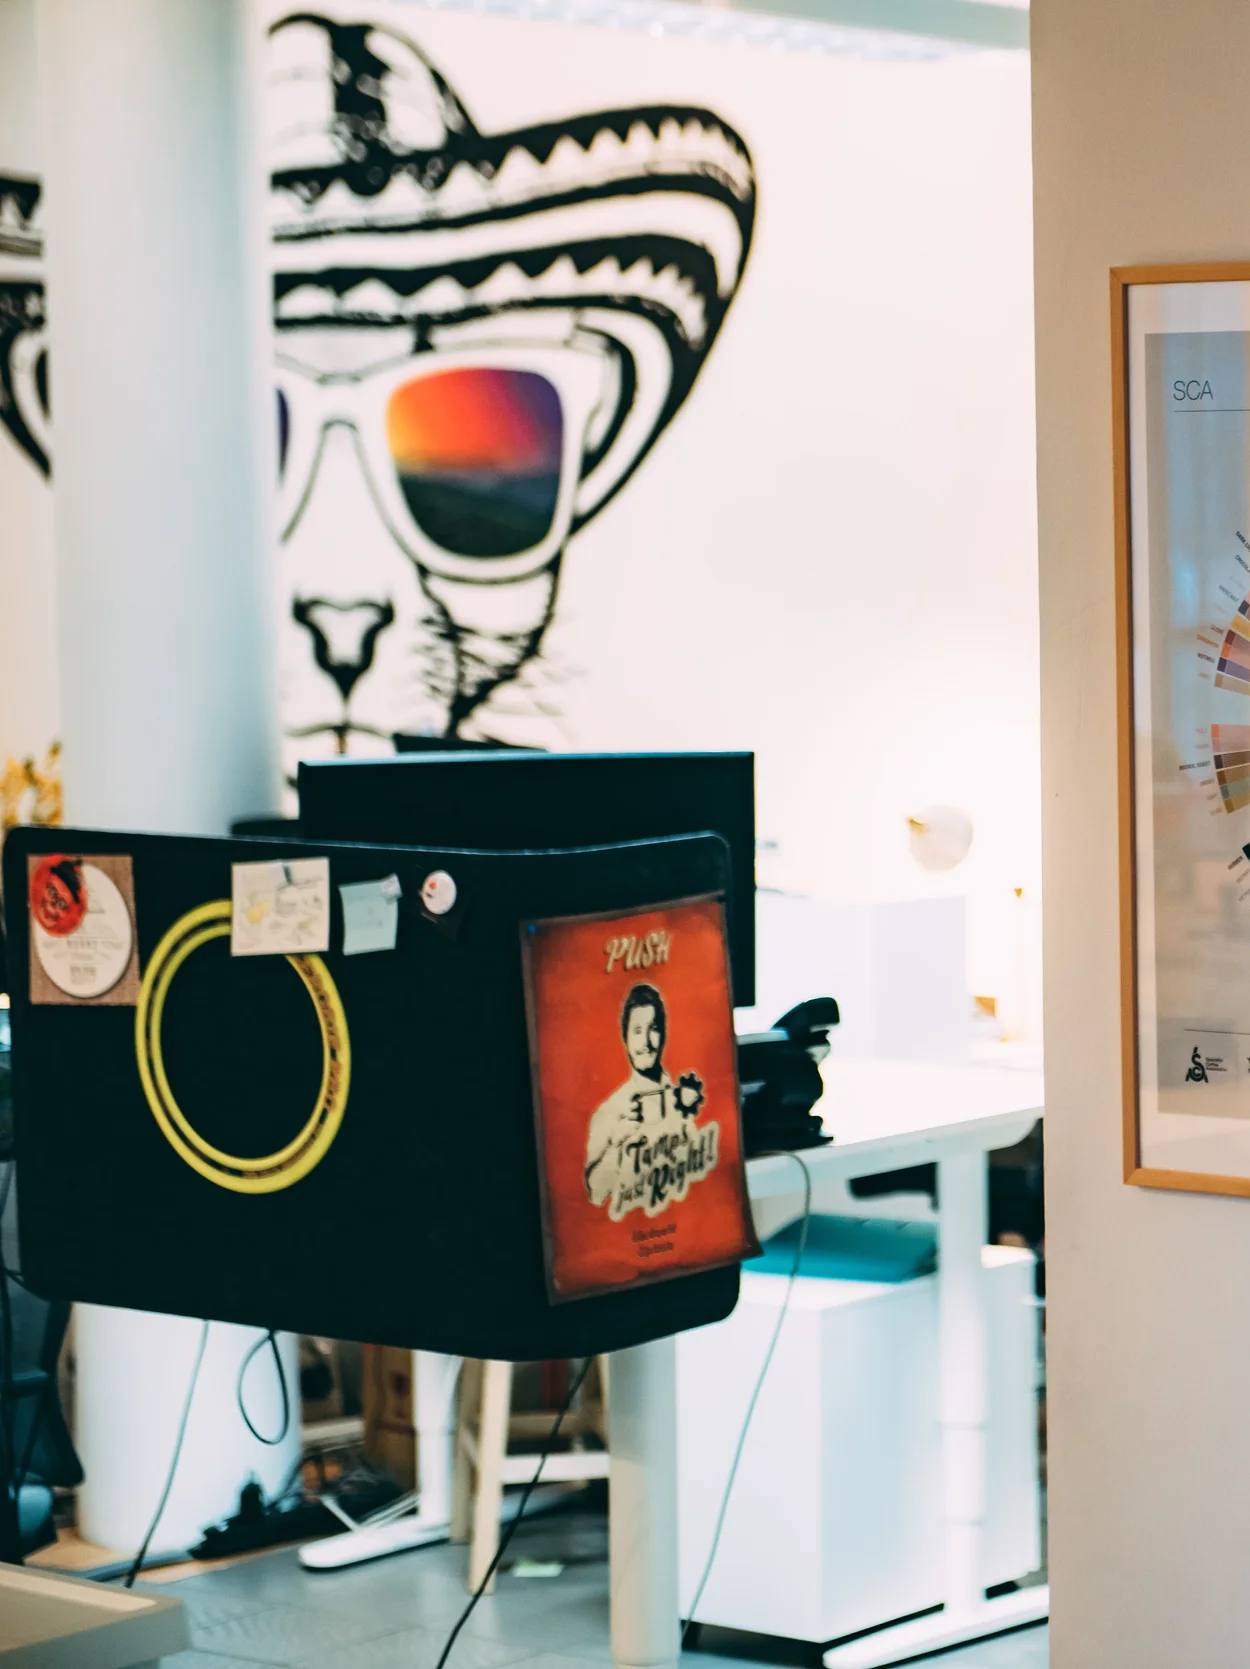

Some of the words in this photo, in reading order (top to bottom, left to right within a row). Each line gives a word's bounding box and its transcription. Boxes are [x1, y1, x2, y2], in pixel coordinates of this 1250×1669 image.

[1173, 380, 1213, 401] SCA
[604, 928, 673, 975] PUSH
[616, 1173, 645, 1213] just
